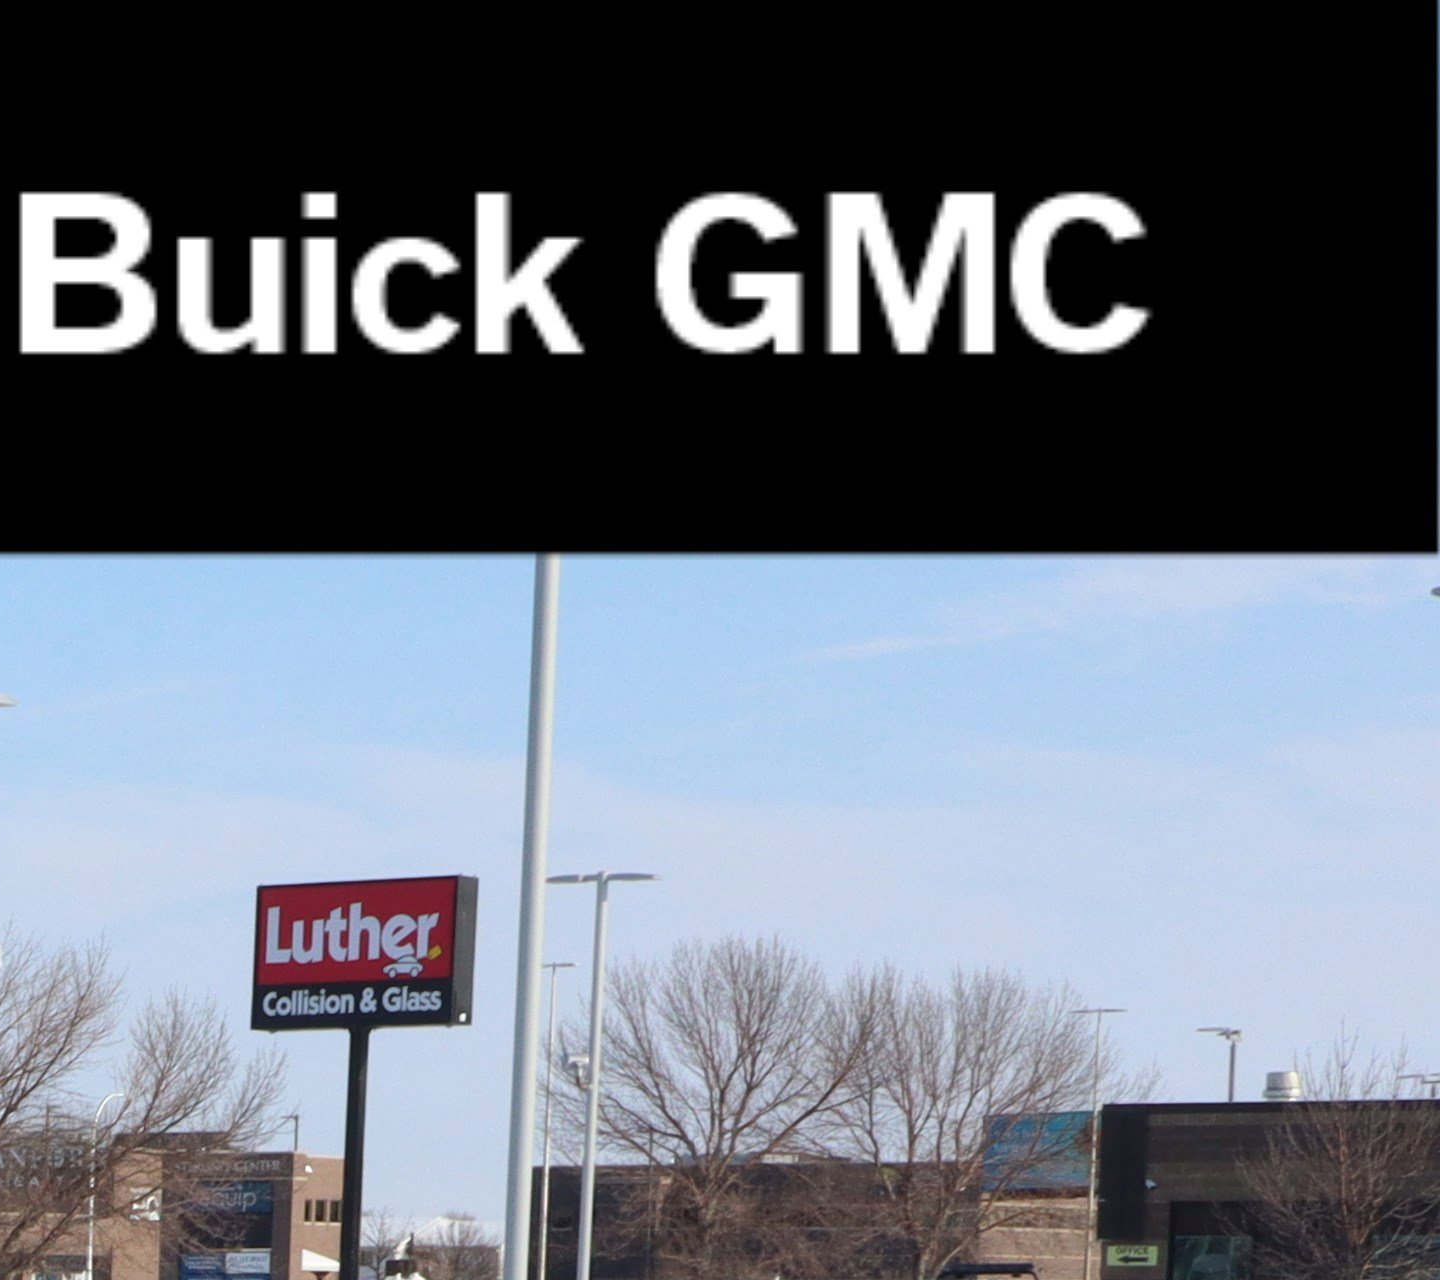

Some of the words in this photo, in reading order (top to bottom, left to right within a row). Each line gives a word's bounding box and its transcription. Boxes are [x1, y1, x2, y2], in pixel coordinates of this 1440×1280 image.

[265, 902, 439, 964] Luther
[262, 988, 355, 1017] Collision
[359, 986, 378, 1014] &
[382, 985, 442, 1013] Glass
